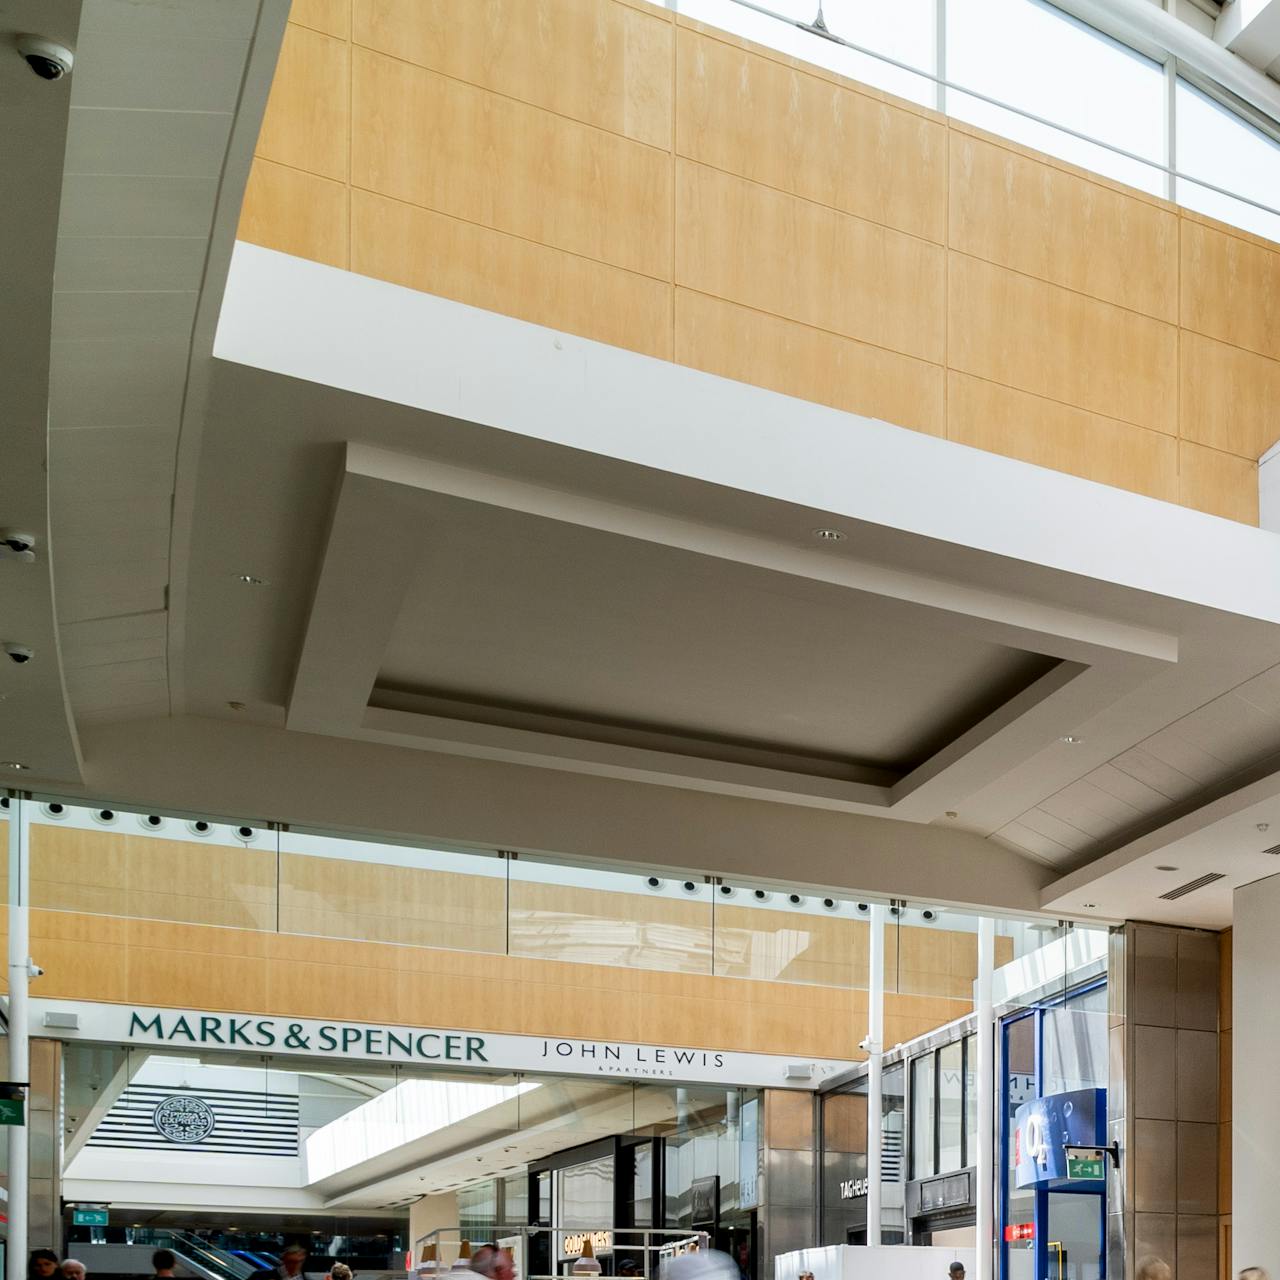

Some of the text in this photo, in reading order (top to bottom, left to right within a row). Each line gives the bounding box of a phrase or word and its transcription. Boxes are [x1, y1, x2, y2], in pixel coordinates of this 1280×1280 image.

[129, 1011, 488, 1062] MARKS & SPENCER
[542, 1041, 724, 1067] JOHN LEWIS
[608, 1066, 673, 1076] PARTNERS
[162, 1117, 207, 1126] EXPRESS
